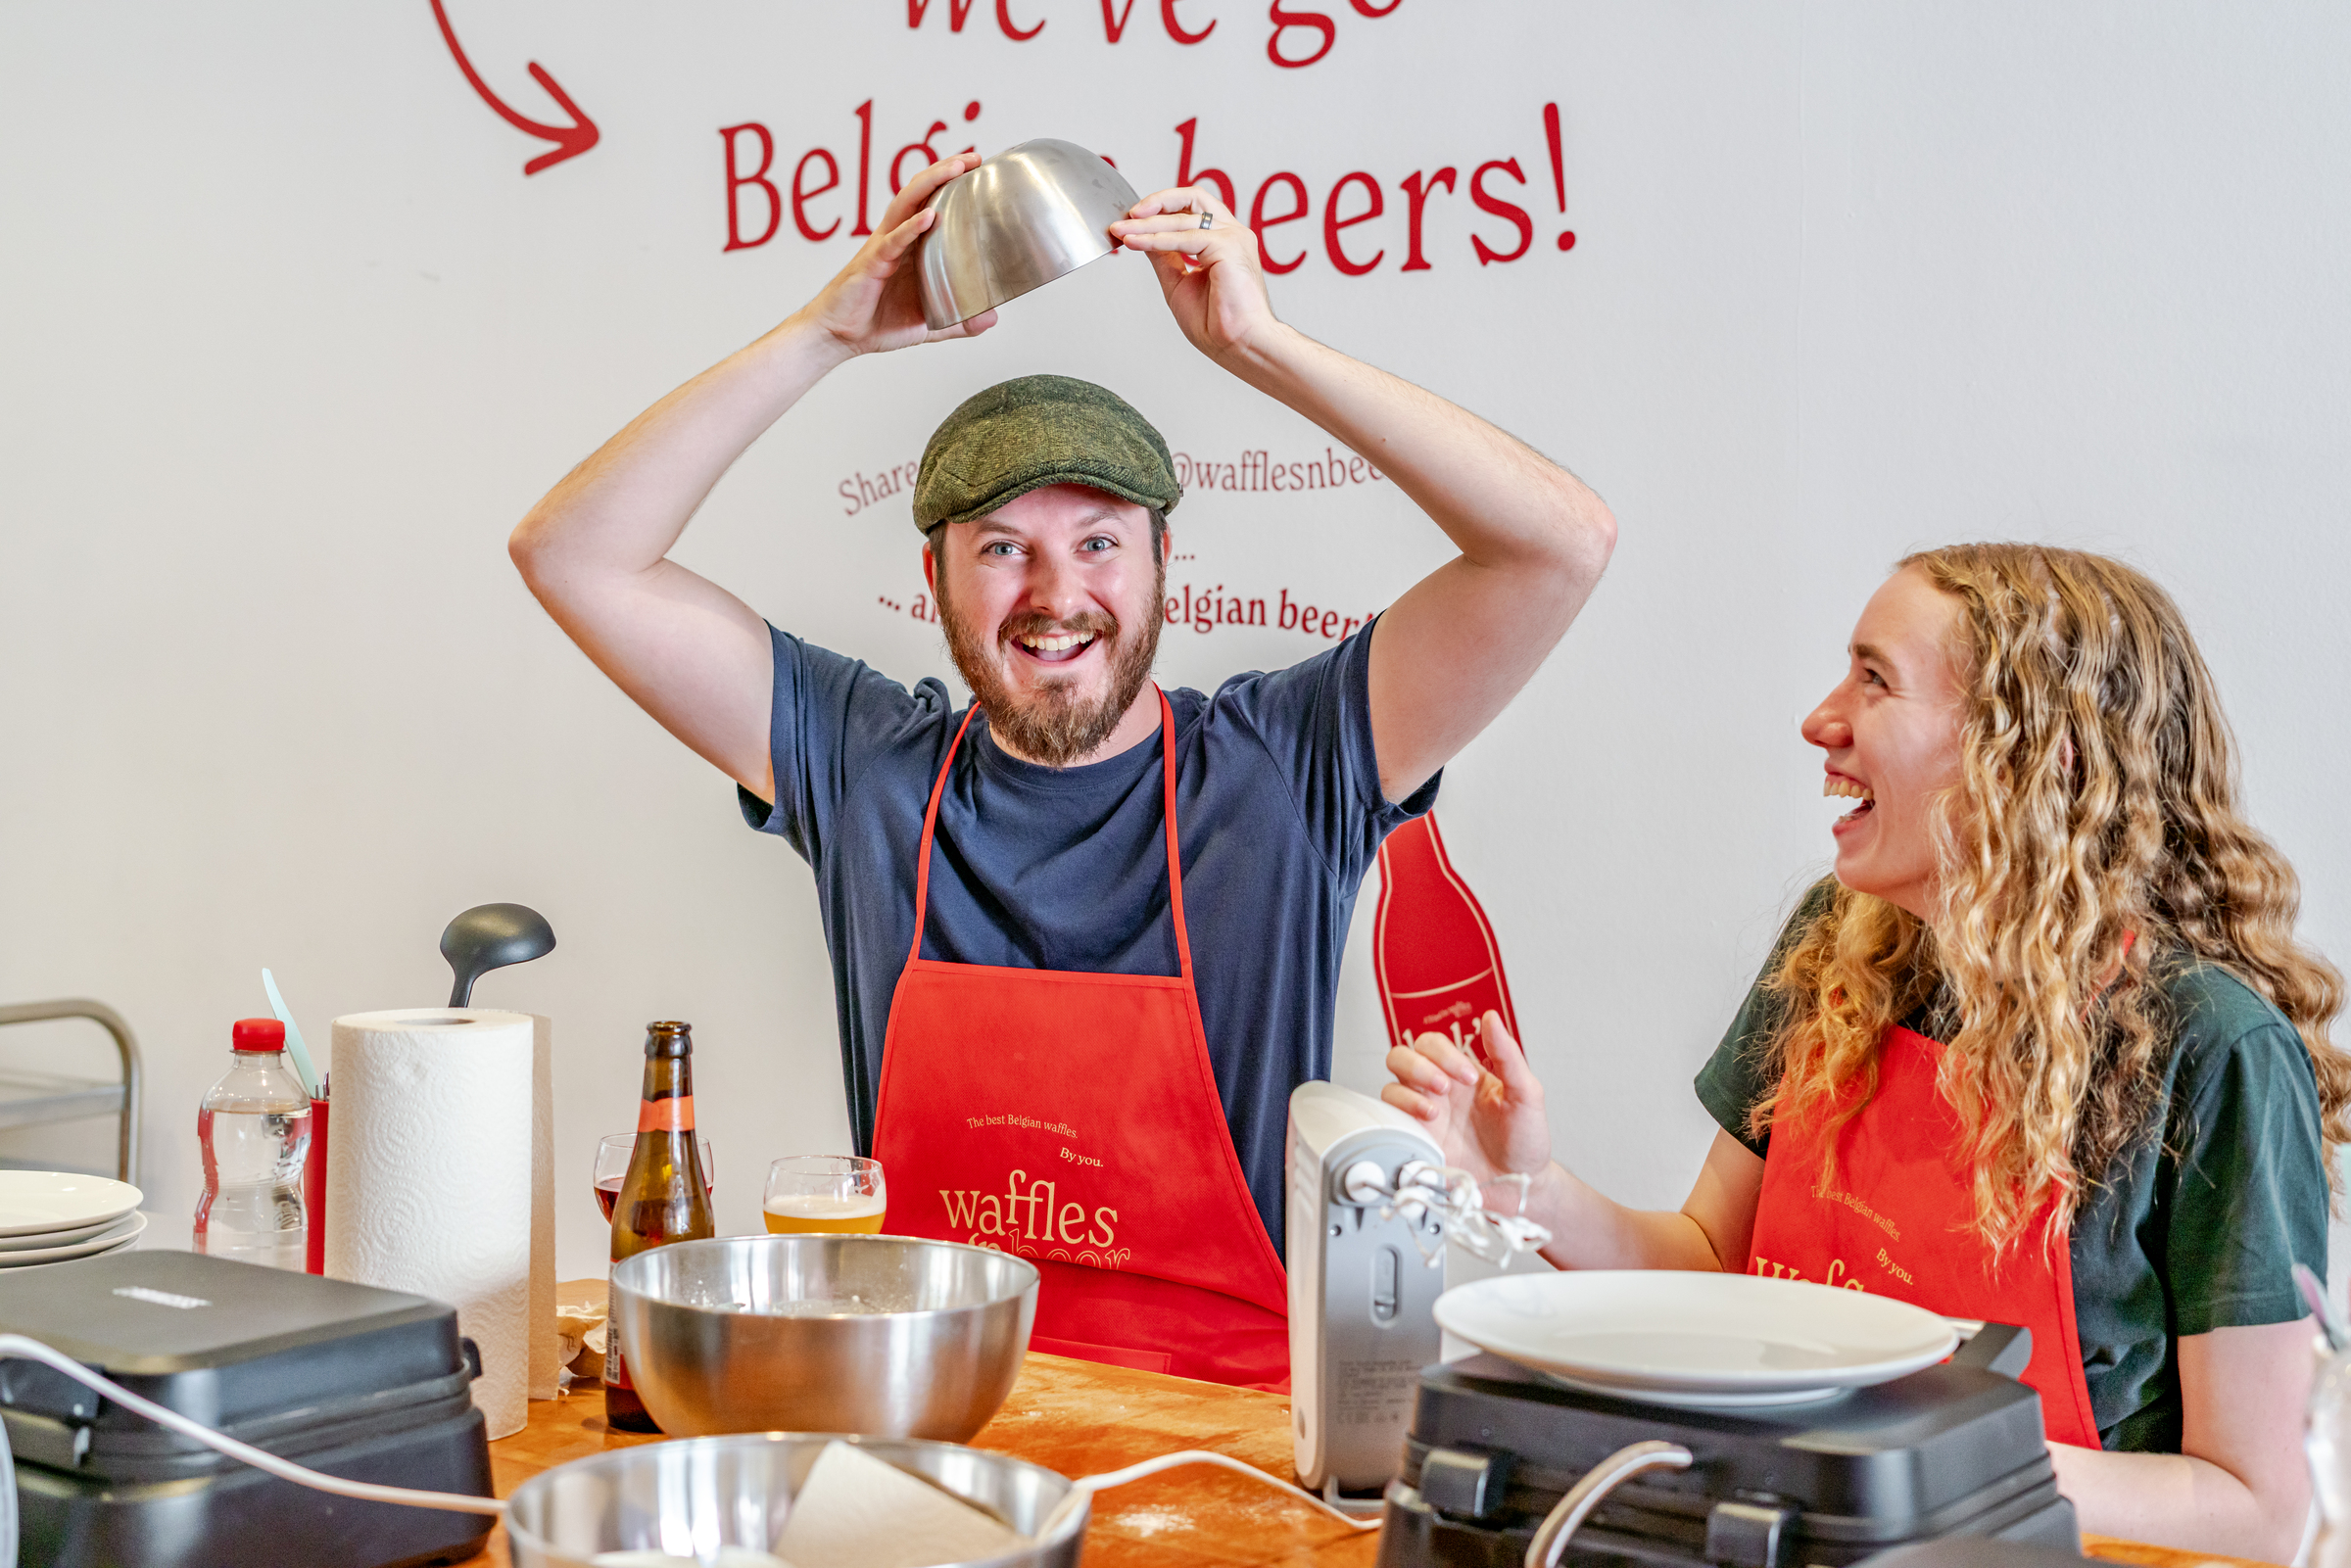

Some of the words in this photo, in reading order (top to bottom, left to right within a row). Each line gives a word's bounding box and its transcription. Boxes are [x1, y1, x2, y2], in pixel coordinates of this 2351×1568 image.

[719, 99, 1119, 254] Belg
[1175, 102, 1576, 276] beers!
[839, 461, 918, 516] Share
[1165, 585, 1267, 634] elgian
[1278, 589, 1373, 641] beer
[967, 1117, 984, 1128] The
[985, 1115, 1005, 1125] best
[1008, 1115, 1041, 1128] Belgian
[1044, 1122, 1078, 1138] waffles.
[1060, 1147, 1077, 1163] By
[1078, 1156, 1104, 1167] you.
[939, 1169, 1118, 1248] waffles
[1844, 1193, 1873, 1218] Belgian
[1874, 1213, 1900, 1242] waffles.
[1876, 1248, 1892, 1267] By
[1889, 1263, 1913, 1285] you.
